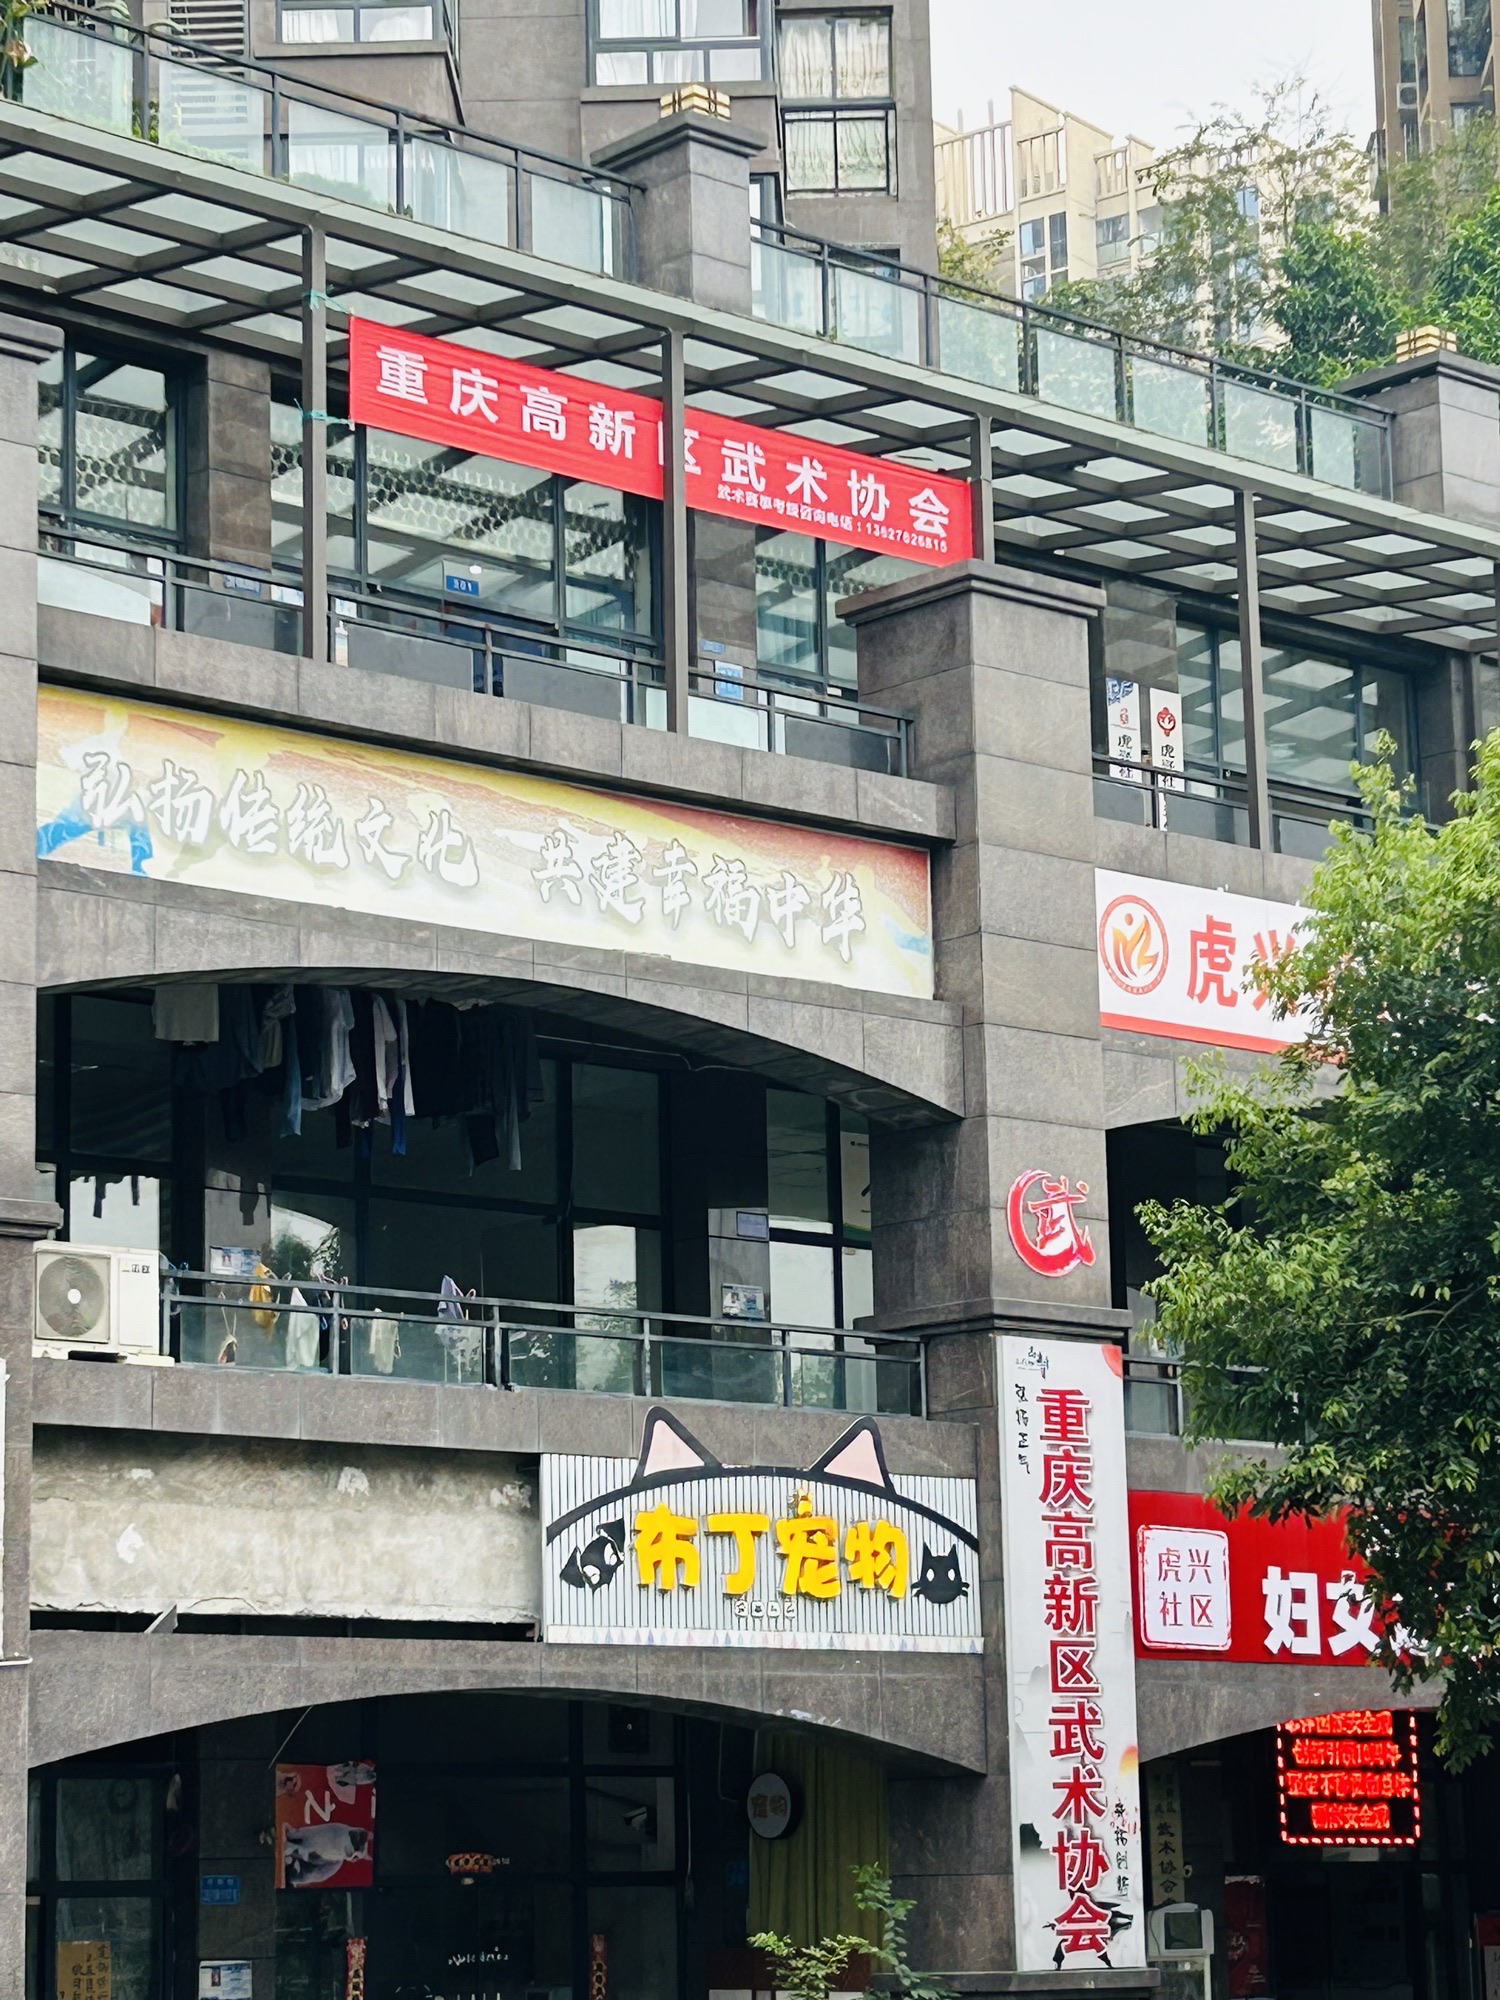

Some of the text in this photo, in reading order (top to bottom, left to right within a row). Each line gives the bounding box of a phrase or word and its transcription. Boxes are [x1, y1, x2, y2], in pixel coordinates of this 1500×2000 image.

[81, 752, 866, 963] 弘扬传统文化 共建幸福中华
[633, 1489, 909, 1601] 布丁宠物
[1157, 1547, 1212, 1584] 虎兴
[1159, 1591, 1215, 1629] 社区
[1035, 1388, 1111, 1956] 重庆高新区武术协会
